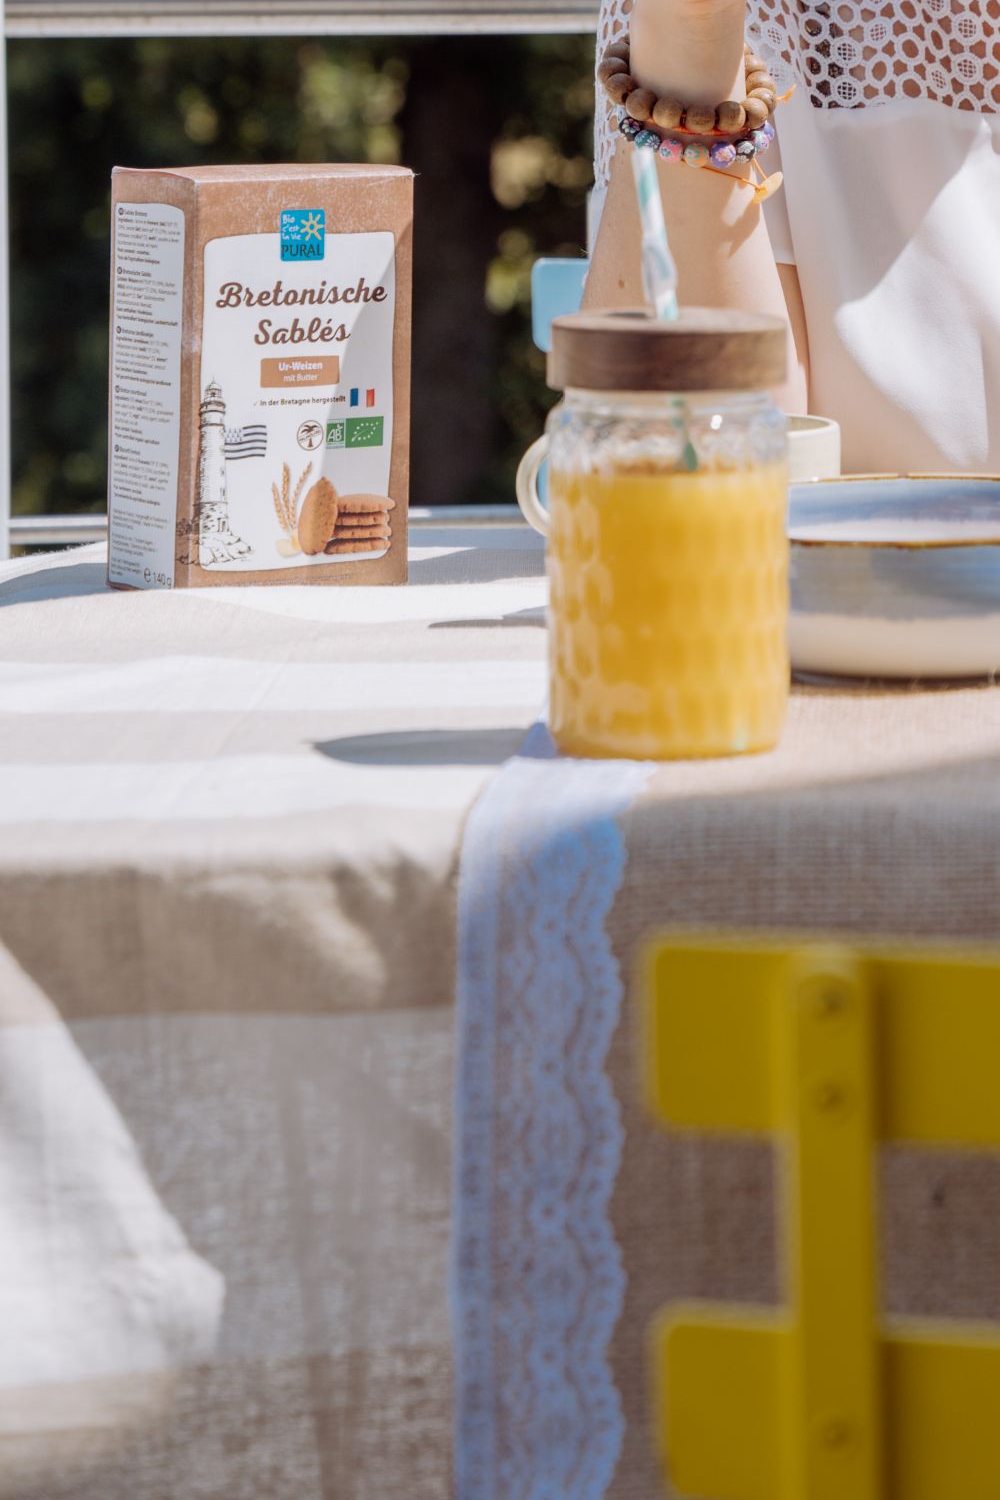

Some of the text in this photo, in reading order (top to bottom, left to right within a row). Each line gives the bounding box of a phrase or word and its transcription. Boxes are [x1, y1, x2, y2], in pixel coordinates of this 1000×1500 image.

[282, 214, 295, 224] Bio
[282, 224, 300, 233] c'est
[281, 243, 322, 258] PURAL
[216, 277, 388, 308] Bretonische
[254, 317, 351, 345] Sablés
[278, 361, 323, 371] Ur-Weizen
[281, 398, 311, 407] Bretagne
[311, 396, 346, 405] hergestellt
[327, 428, 342, 442] AB
[153, 571, 166, 586] 140
[166, 577, 172, 590] g
